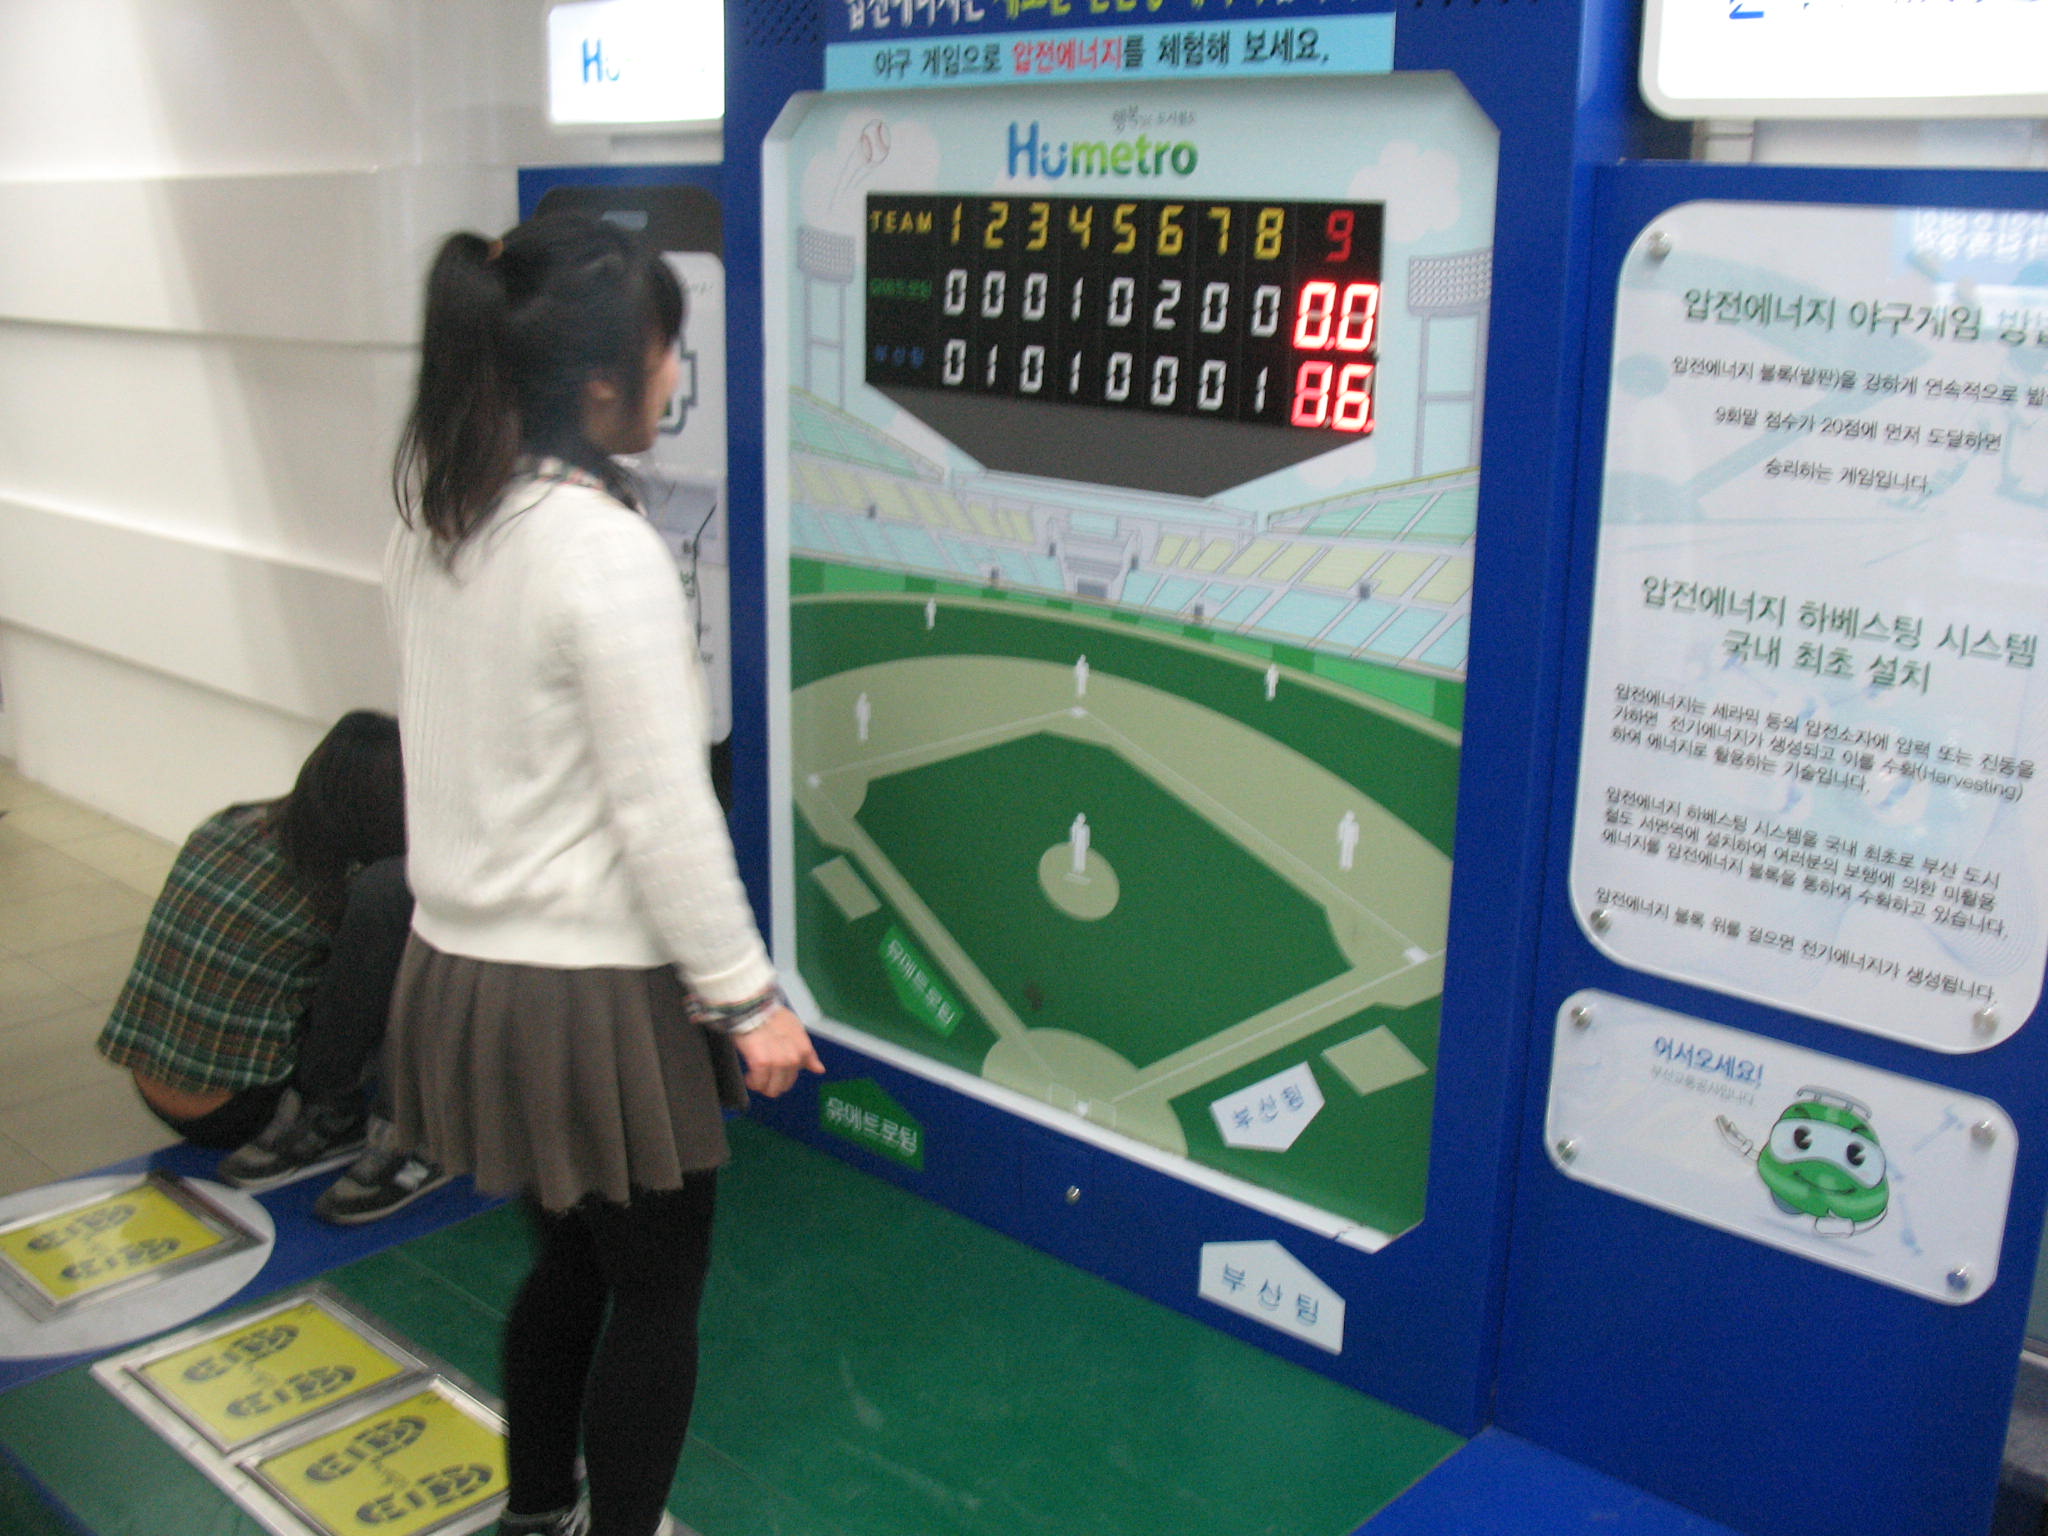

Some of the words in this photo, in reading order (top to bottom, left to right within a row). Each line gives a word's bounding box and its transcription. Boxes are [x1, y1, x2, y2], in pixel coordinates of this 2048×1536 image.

[876, 47, 911, 78] 야구
[923, 42, 1002, 77] 게임으로
[1013, 33, 1144, 74] 압전에너지를
[1158, 30, 1231, 67] 체험해
[870, 210, 932, 234] TEAM
[951, 202, 962, 245] 1
[984, 201, 1009, 249] 2
[1026, 202, 1049, 250] 3
[1069, 205, 1093, 249] 4
[1112, 204, 1137, 254] 5
[1157, 205, 1184, 256] 6
[1208, 206, 1231, 256] 7
[1254, 207, 1285, 260] 8
[1325, 210, 1354, 262] 9
[944, 269, 968, 316] 0
[981, 271, 1006, 318] 0
[1022, 273, 1048, 321] 0
[1107, 277, 1135, 326] 0
[1153, 279, 1181, 330] 2
[1201, 282, 1229, 333] 0
[1251, 284, 1281, 338] 0
[1684, 289, 1836, 332] 압전에너지
[1849, 299, 1983, 341] 야구게임
[943, 339, 967, 385] 0
[1020, 345, 1045, 393] 0
[1105, 352, 1133, 401] 0
[1151, 356, 1179, 405] 0
[1197, 360, 1227, 411] 0
[1673, 355, 1754, 380] 압전에너지
[1641, 575, 1787, 628] 압전에너지
[1795, 600, 1924, 652] 하베스팅
[1936, 623, 2039, 669] 시스템
[1721, 628, 1782, 670] 국내
[1793, 641, 1854, 681] 최초
[1867, 653, 1932, 697] 설치
